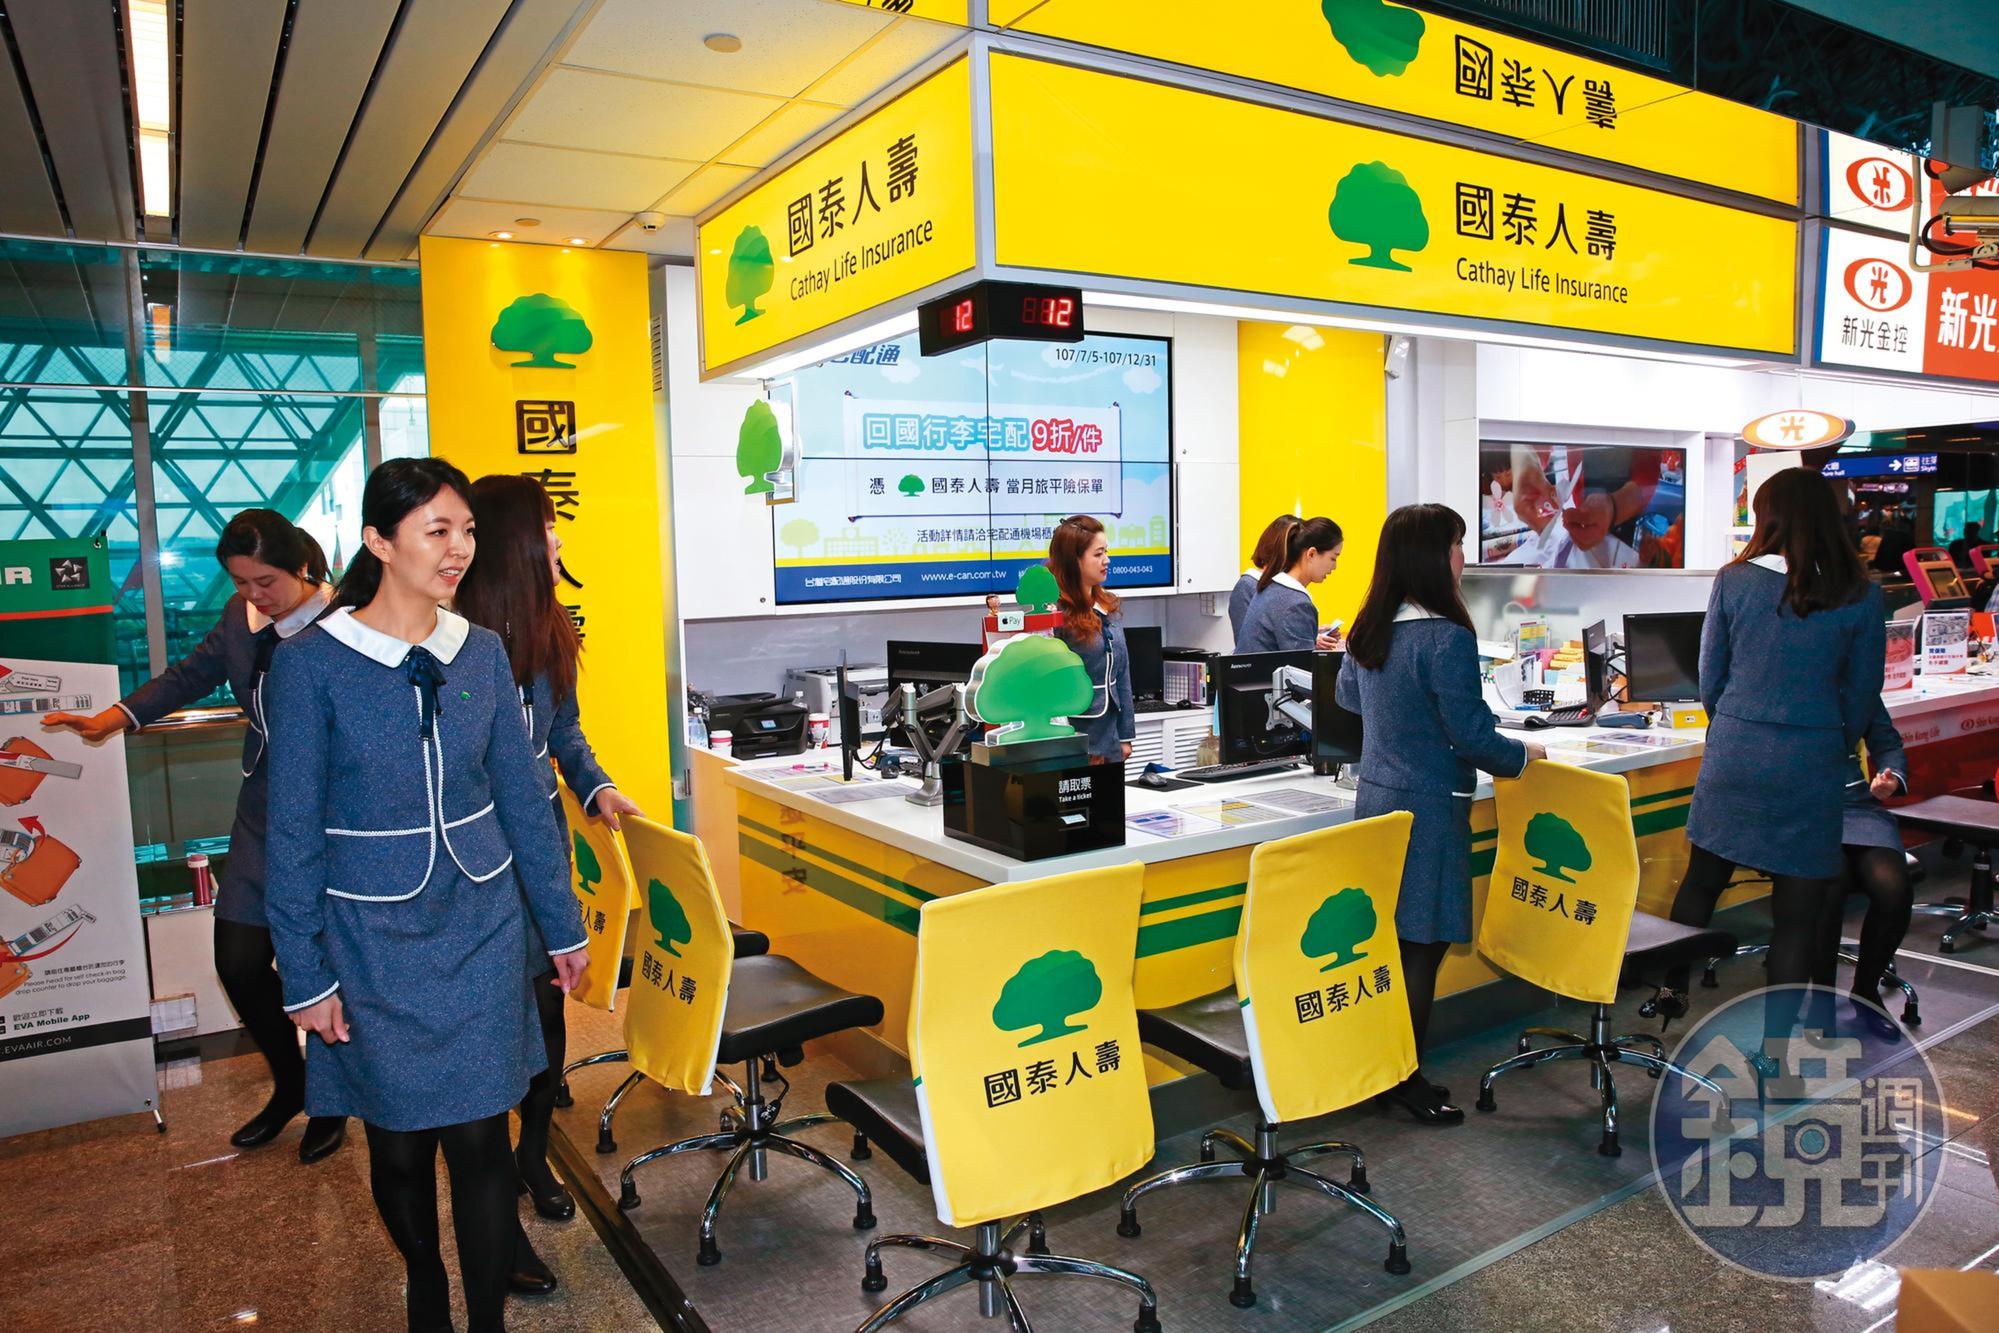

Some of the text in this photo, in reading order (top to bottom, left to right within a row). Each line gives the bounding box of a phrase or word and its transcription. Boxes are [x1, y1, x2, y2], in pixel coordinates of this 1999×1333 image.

[787, 133, 919, 258] 國泰人壽
[1455, 181, 1618, 261] 國泰人壽
[790, 219, 933, 301] Cathay Life Insurance
[1456, 257, 1629, 304] Cathay Life Insurance
[956, 300, 973, 332] 12
[1050, 299, 1072, 327] 12
[1937, 286, 1999, 353] 新光
[1841, 315, 1909, 354] 新光金控
[831, 344, 901, 367] 配通
[1055, 348, 1157, 367] 107/7/5-107/12/31
[869, 477, 1104, 496] 憑 國泰人壽 當月旅平險保單
[916, 526, 1057, 543] 活動詳情請洽宅配通機場櫃
[0, 566, 33, 585] R
[921, 569, 1007, 582] www.e-can.com.tw
[1008, 616, 1022, 627] Pay
[1058, 776, 1092, 793] 請取票
[1077, 792, 1092, 800] ticket
[1511, 876, 1598, 926] 國泰人壽
[15, 987, 31, 996] drop
[32, 984, 58, 994] counter
[66, 980, 82, 989] drop
[83, 979, 97, 987] your
[24, 979, 45, 988] Please
[46, 976, 63, 985] head
[113, 968, 126, 977] bag
[642, 950, 697, 1005] 國泰人壽
[1295, 964, 1391, 1024] 國泰人壽
[14, 1013, 90, 1031] EVA Mobile App
[984, 1040, 1121, 1108] 國泰人壽
